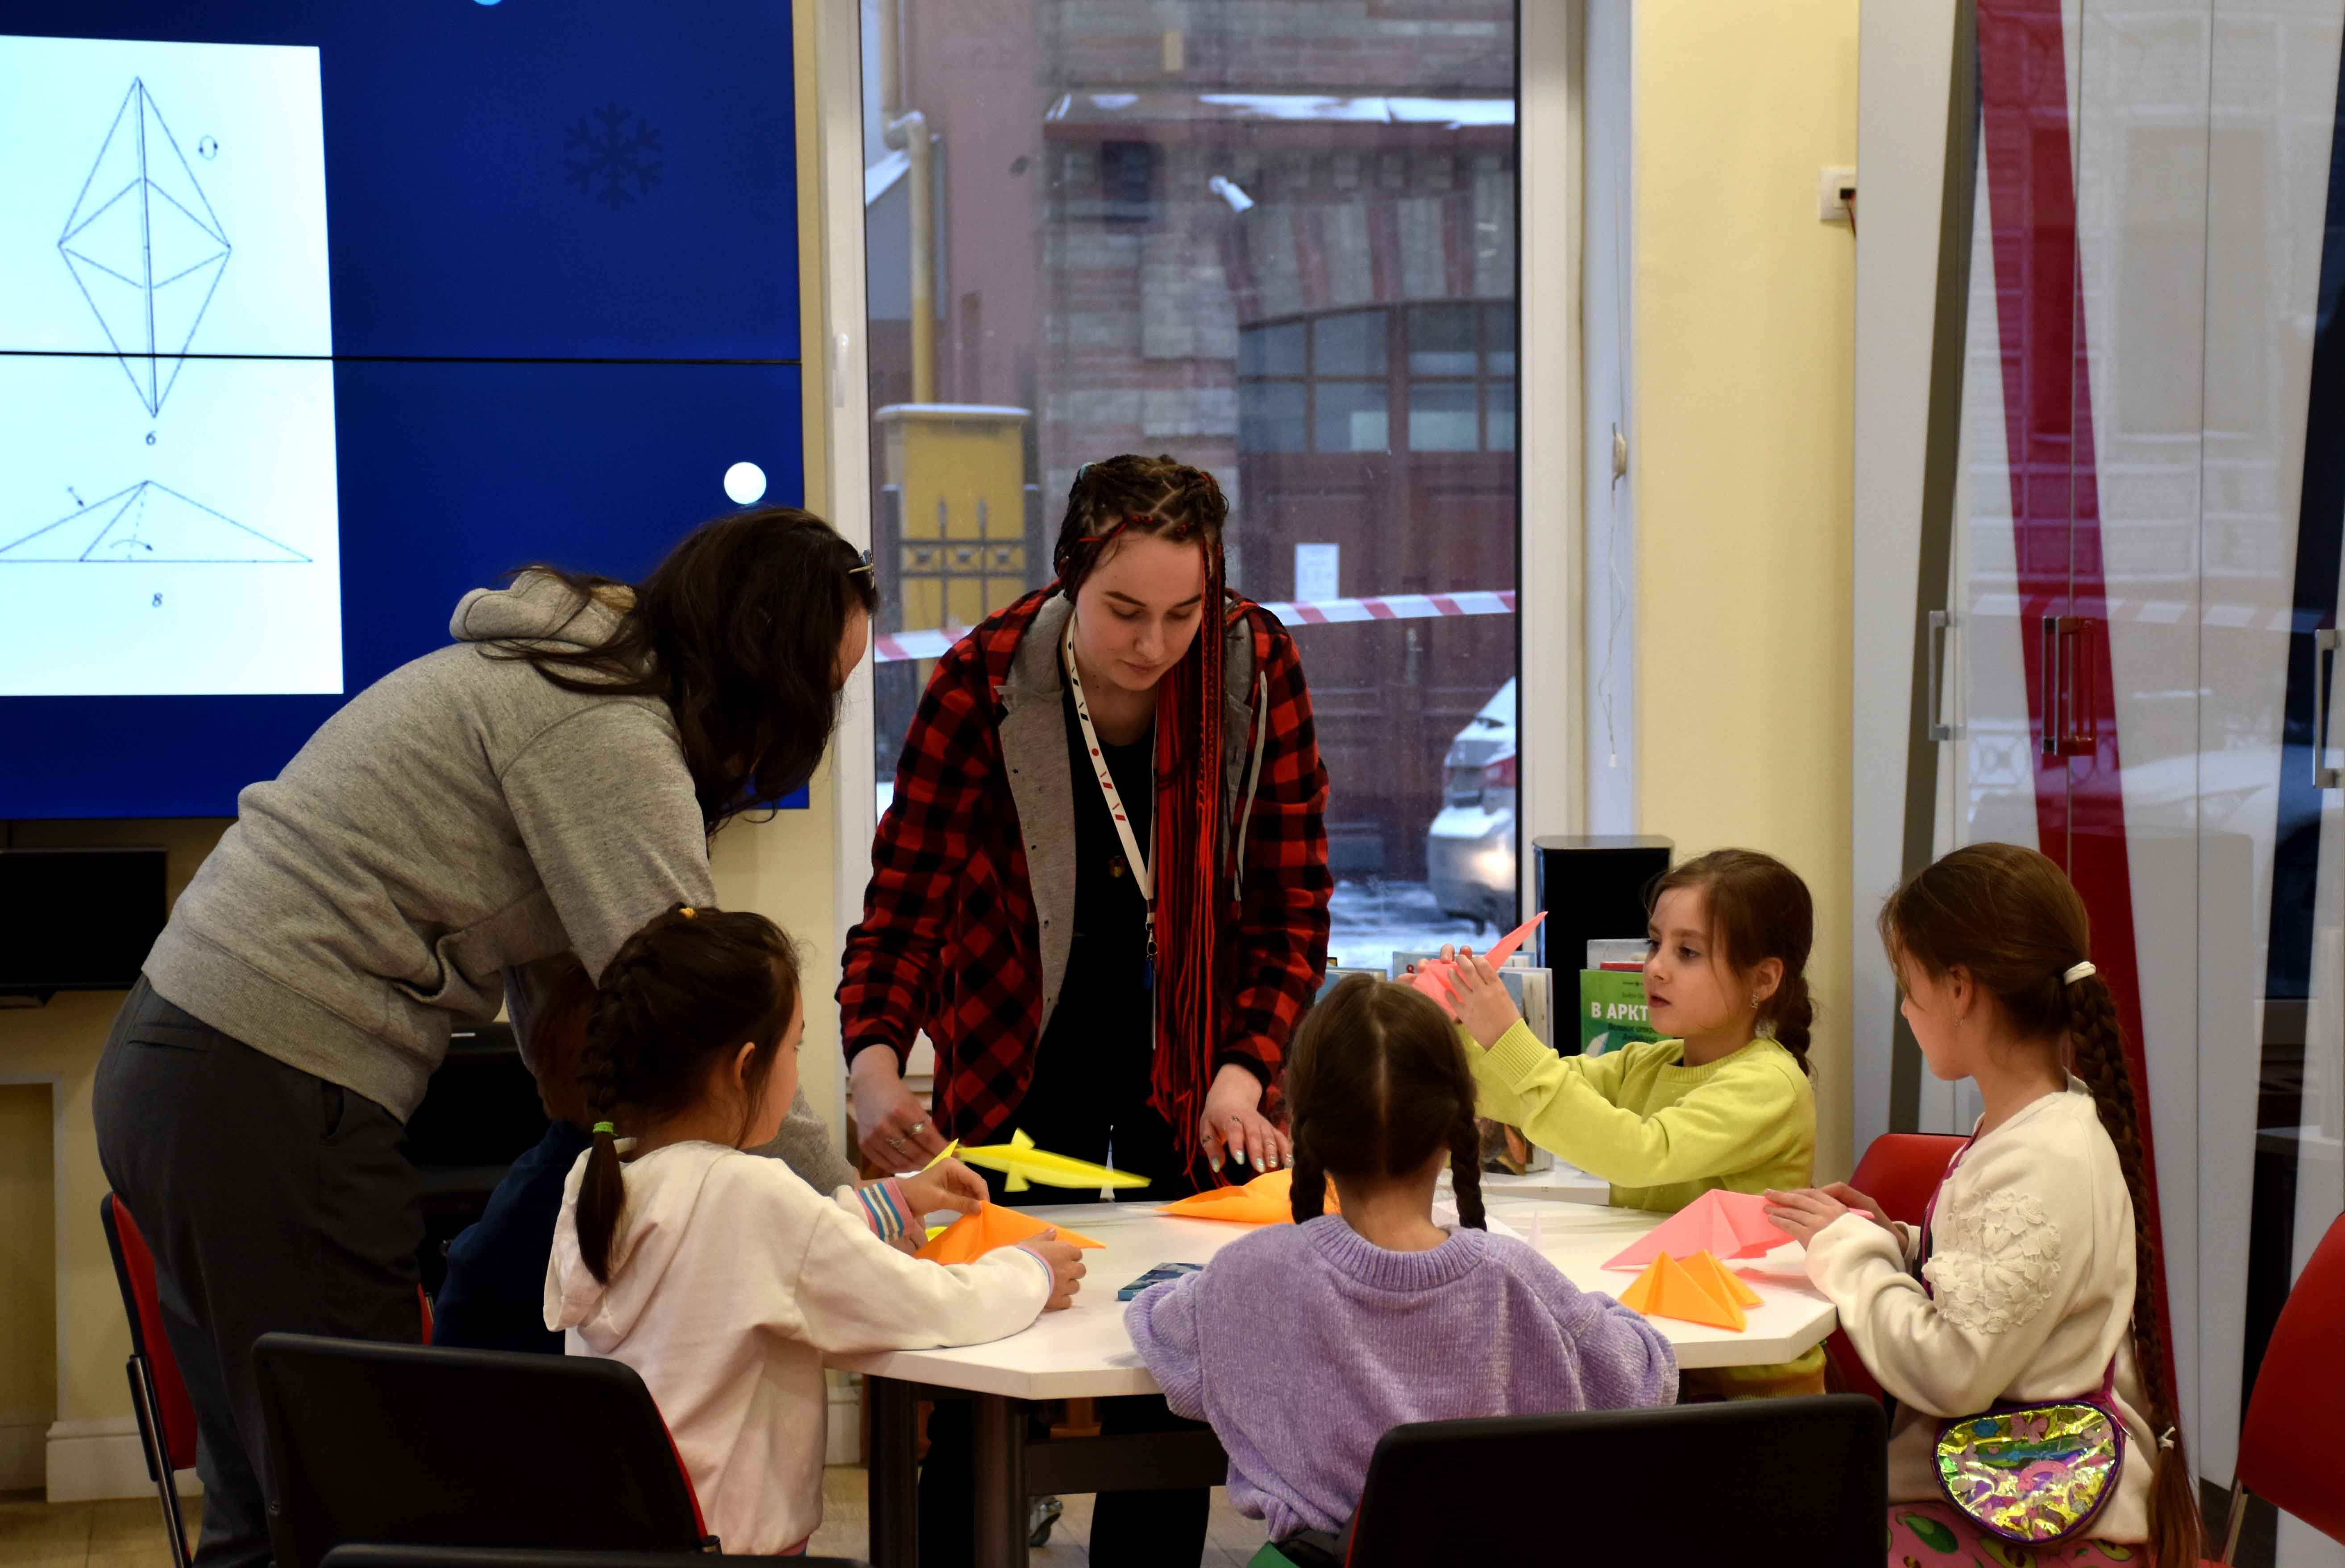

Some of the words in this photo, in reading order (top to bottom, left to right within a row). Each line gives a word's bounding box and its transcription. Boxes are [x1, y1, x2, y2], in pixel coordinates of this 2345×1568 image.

[146, 431, 156, 446] 6
[153, 593, 162, 607] 8
[1591, 1002, 1602, 1018] В
